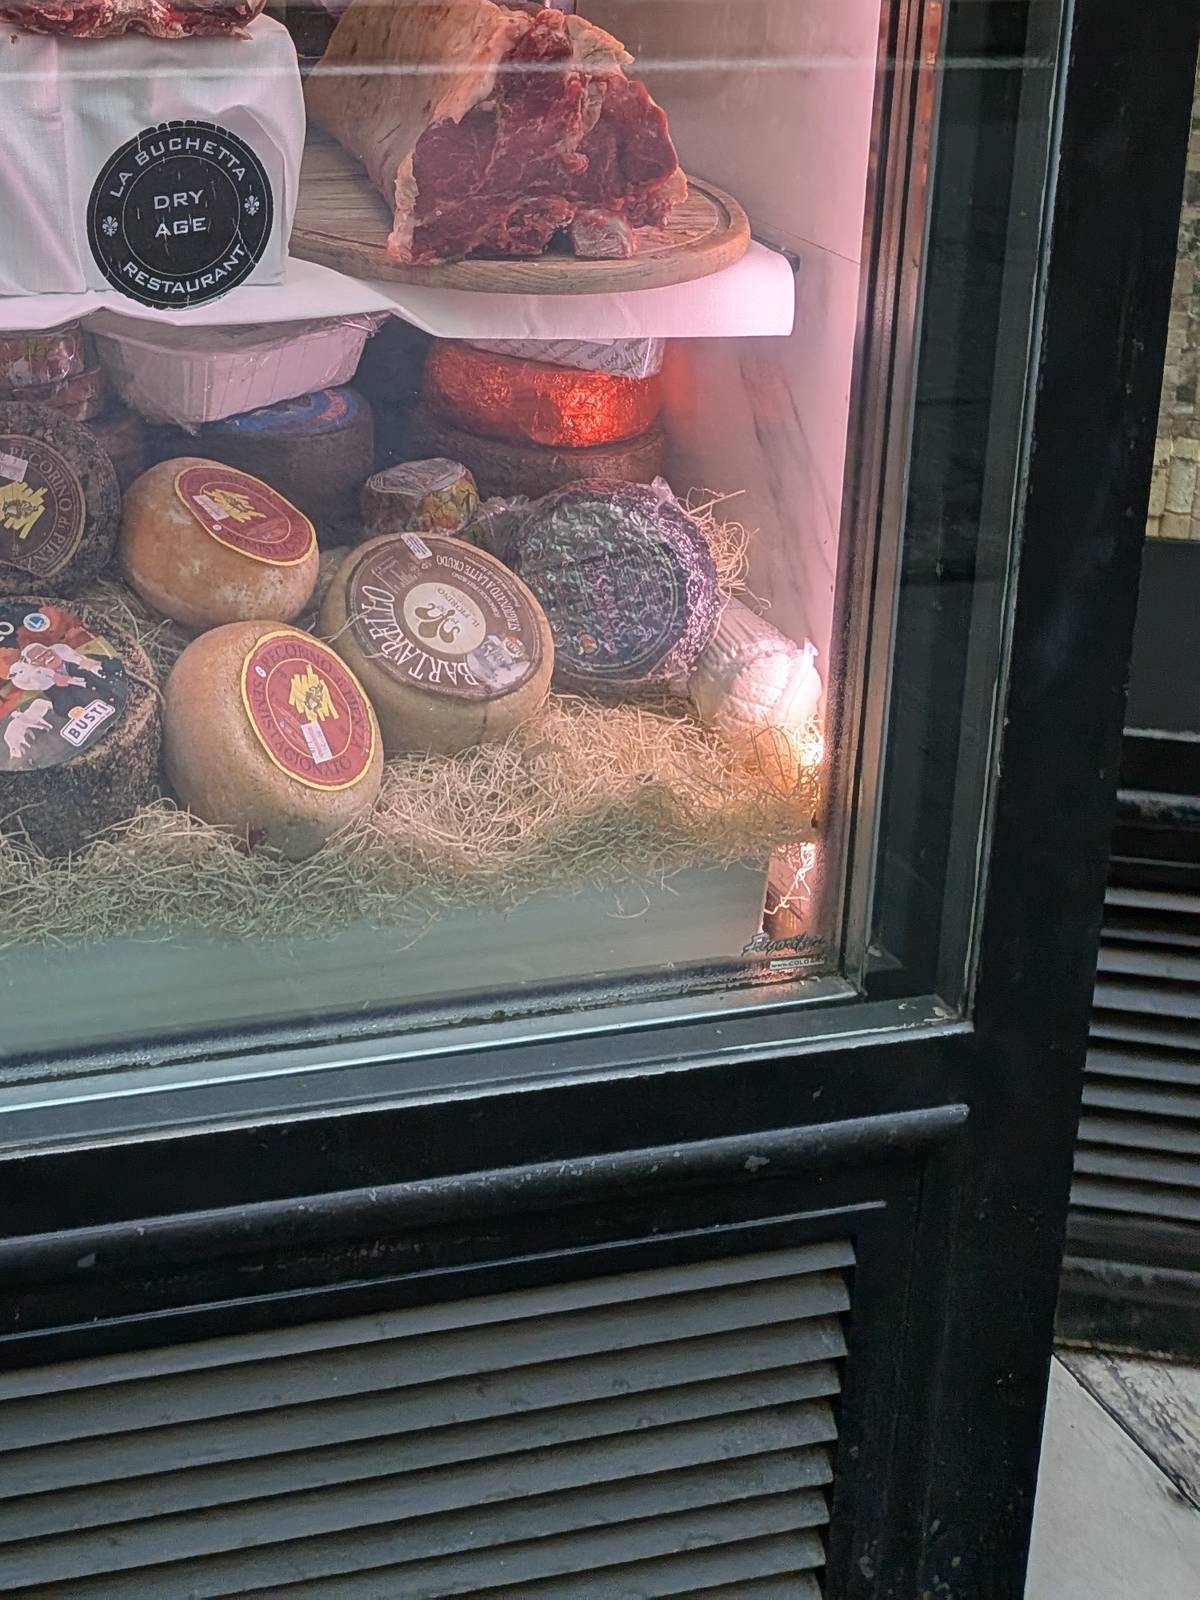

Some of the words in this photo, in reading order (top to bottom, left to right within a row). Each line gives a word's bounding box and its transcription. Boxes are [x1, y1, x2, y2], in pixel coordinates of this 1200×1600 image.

[110, 170, 133, 198] LA
[135, 138, 248, 182] BUCHETTA
[154, 189, 204, 210] DRY
[154, 217, 207, 238] AGE
[122, 245, 247, 294] RESTAURANT
[435, 554, 464, 572] CRUDO
[68, 704, 108, 740] BUSTI
